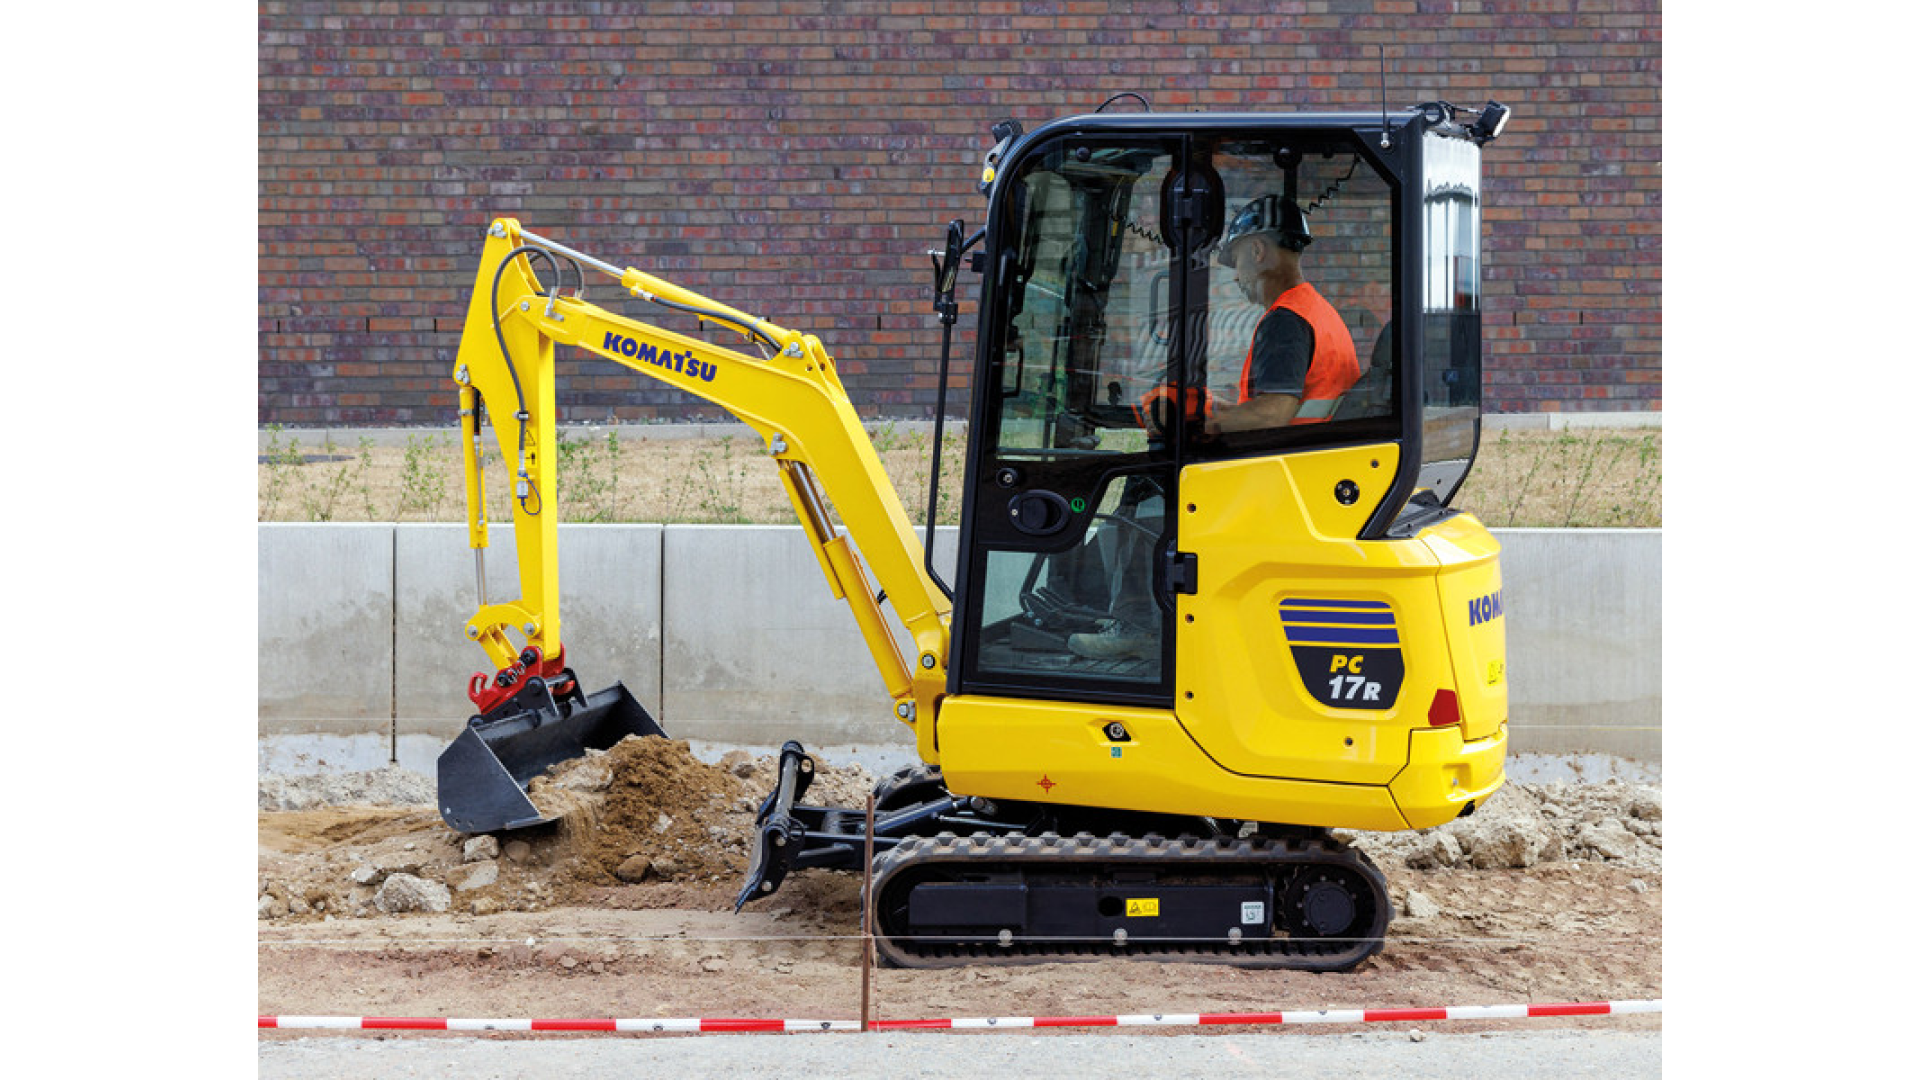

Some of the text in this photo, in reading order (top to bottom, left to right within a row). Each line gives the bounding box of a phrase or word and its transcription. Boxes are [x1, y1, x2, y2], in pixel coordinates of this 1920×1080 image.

[603, 331, 717, 382] KOMATSU
[1328, 654, 1364, 674] PC
[1328, 674, 1382, 701] 17R
